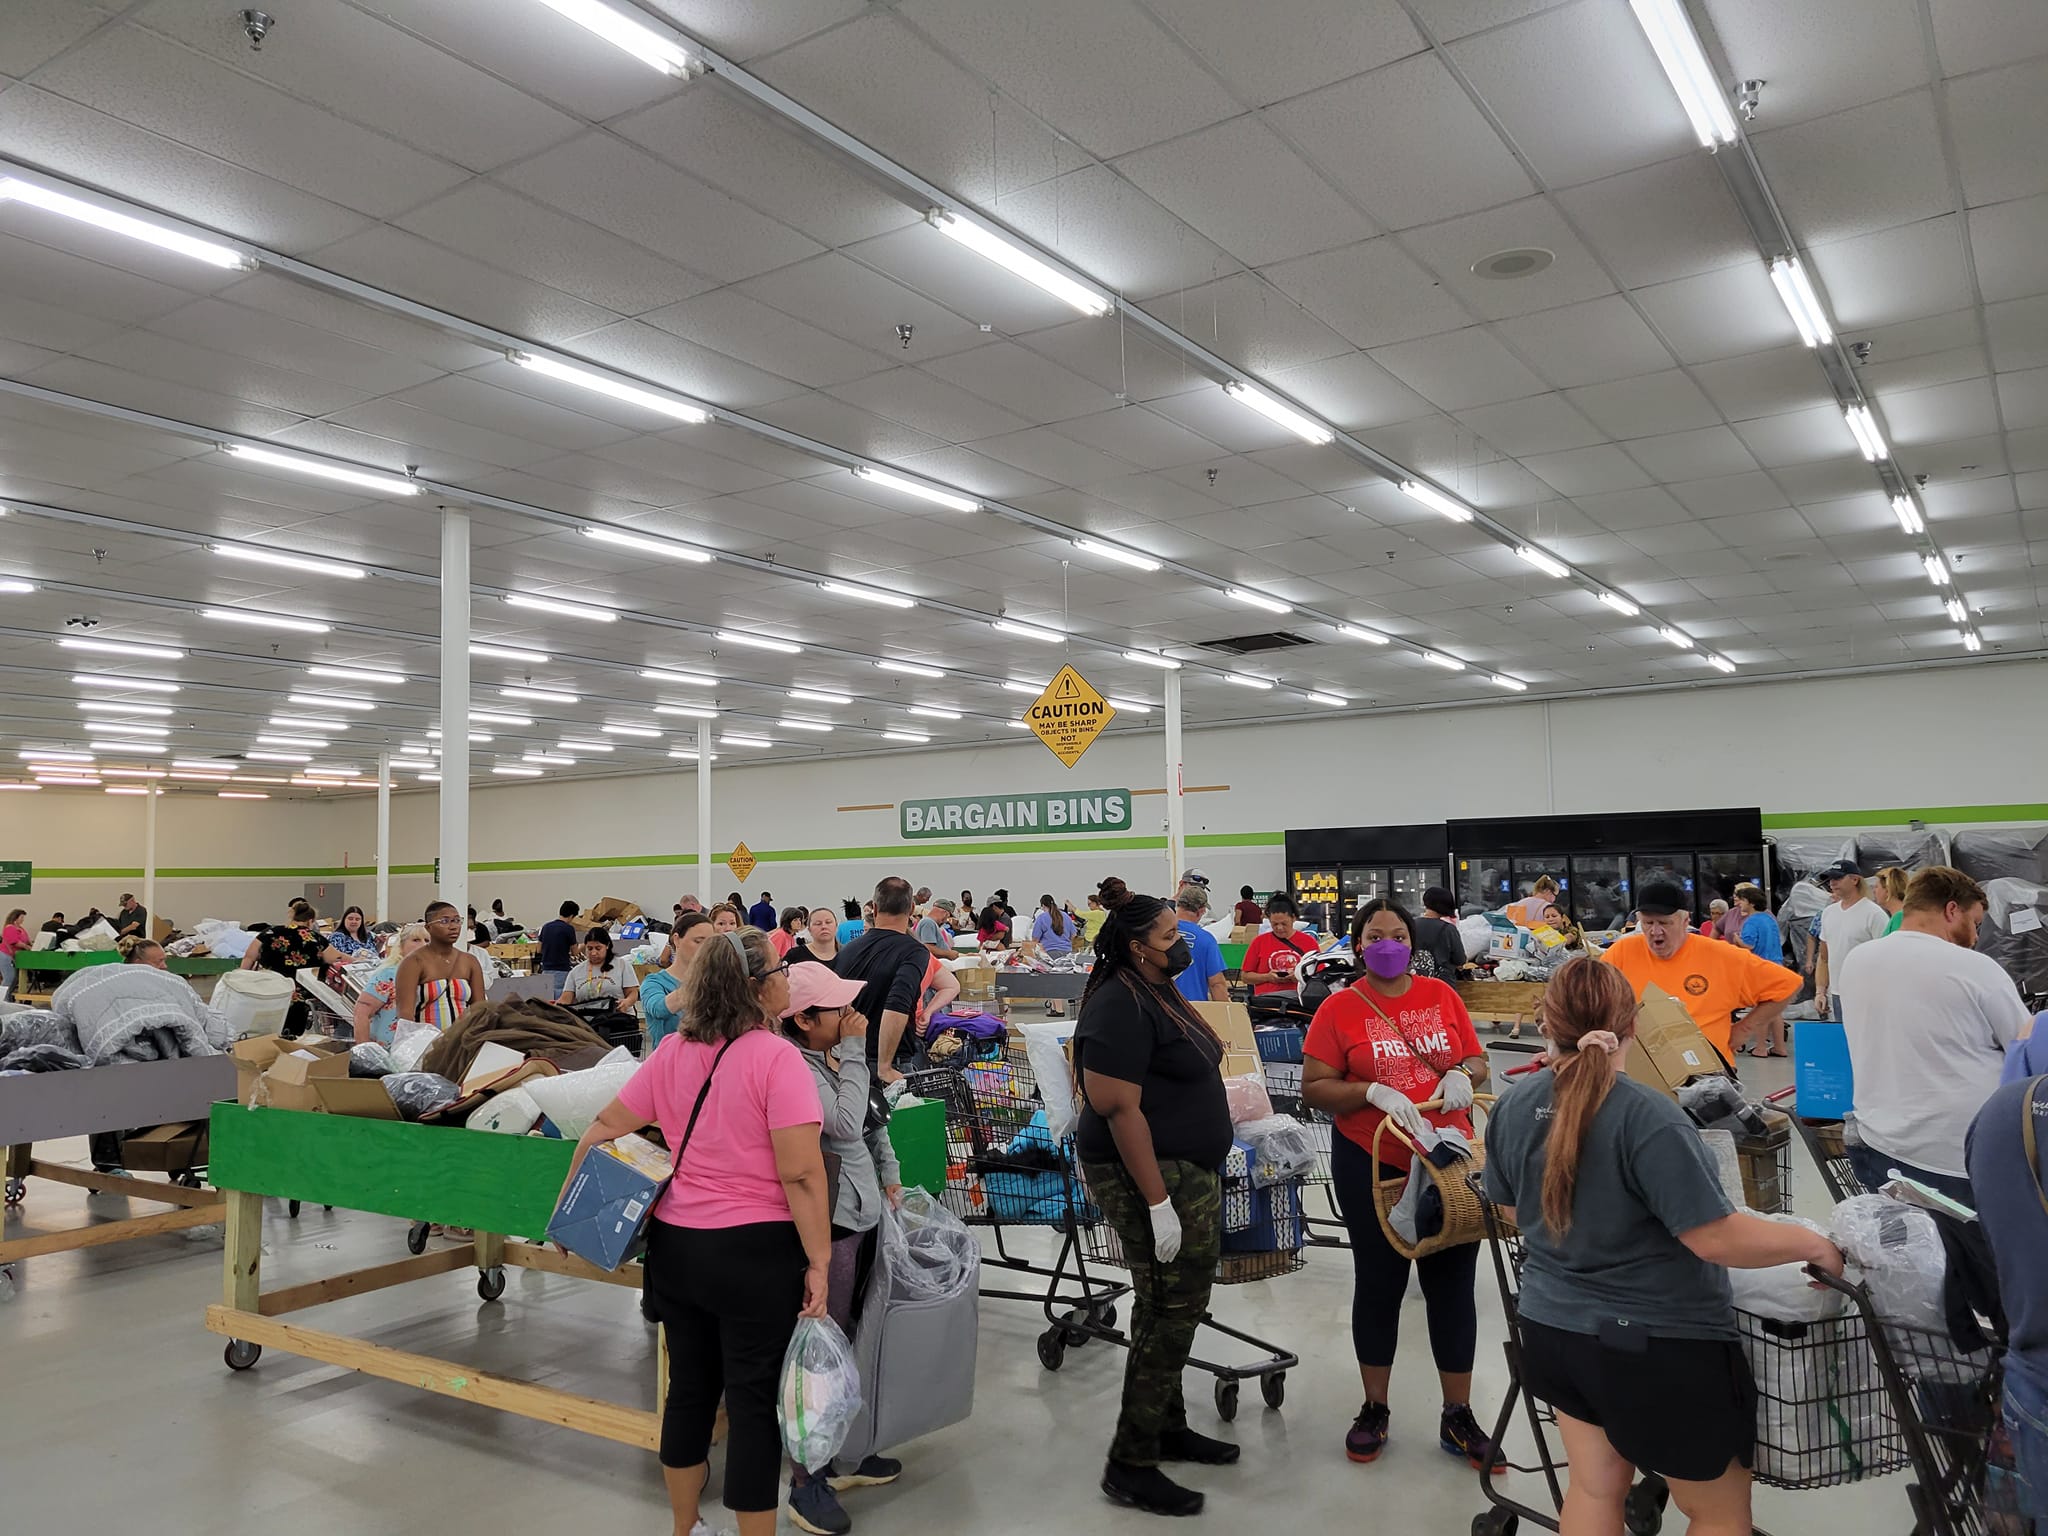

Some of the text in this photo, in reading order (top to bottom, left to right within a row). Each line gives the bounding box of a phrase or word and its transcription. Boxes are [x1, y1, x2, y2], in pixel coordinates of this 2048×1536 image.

[1032, 702, 1103, 718] CAUTION
[905, 796, 1125, 832] BARGAIN BINS
[1372, 1040, 1409, 1058] FREE
